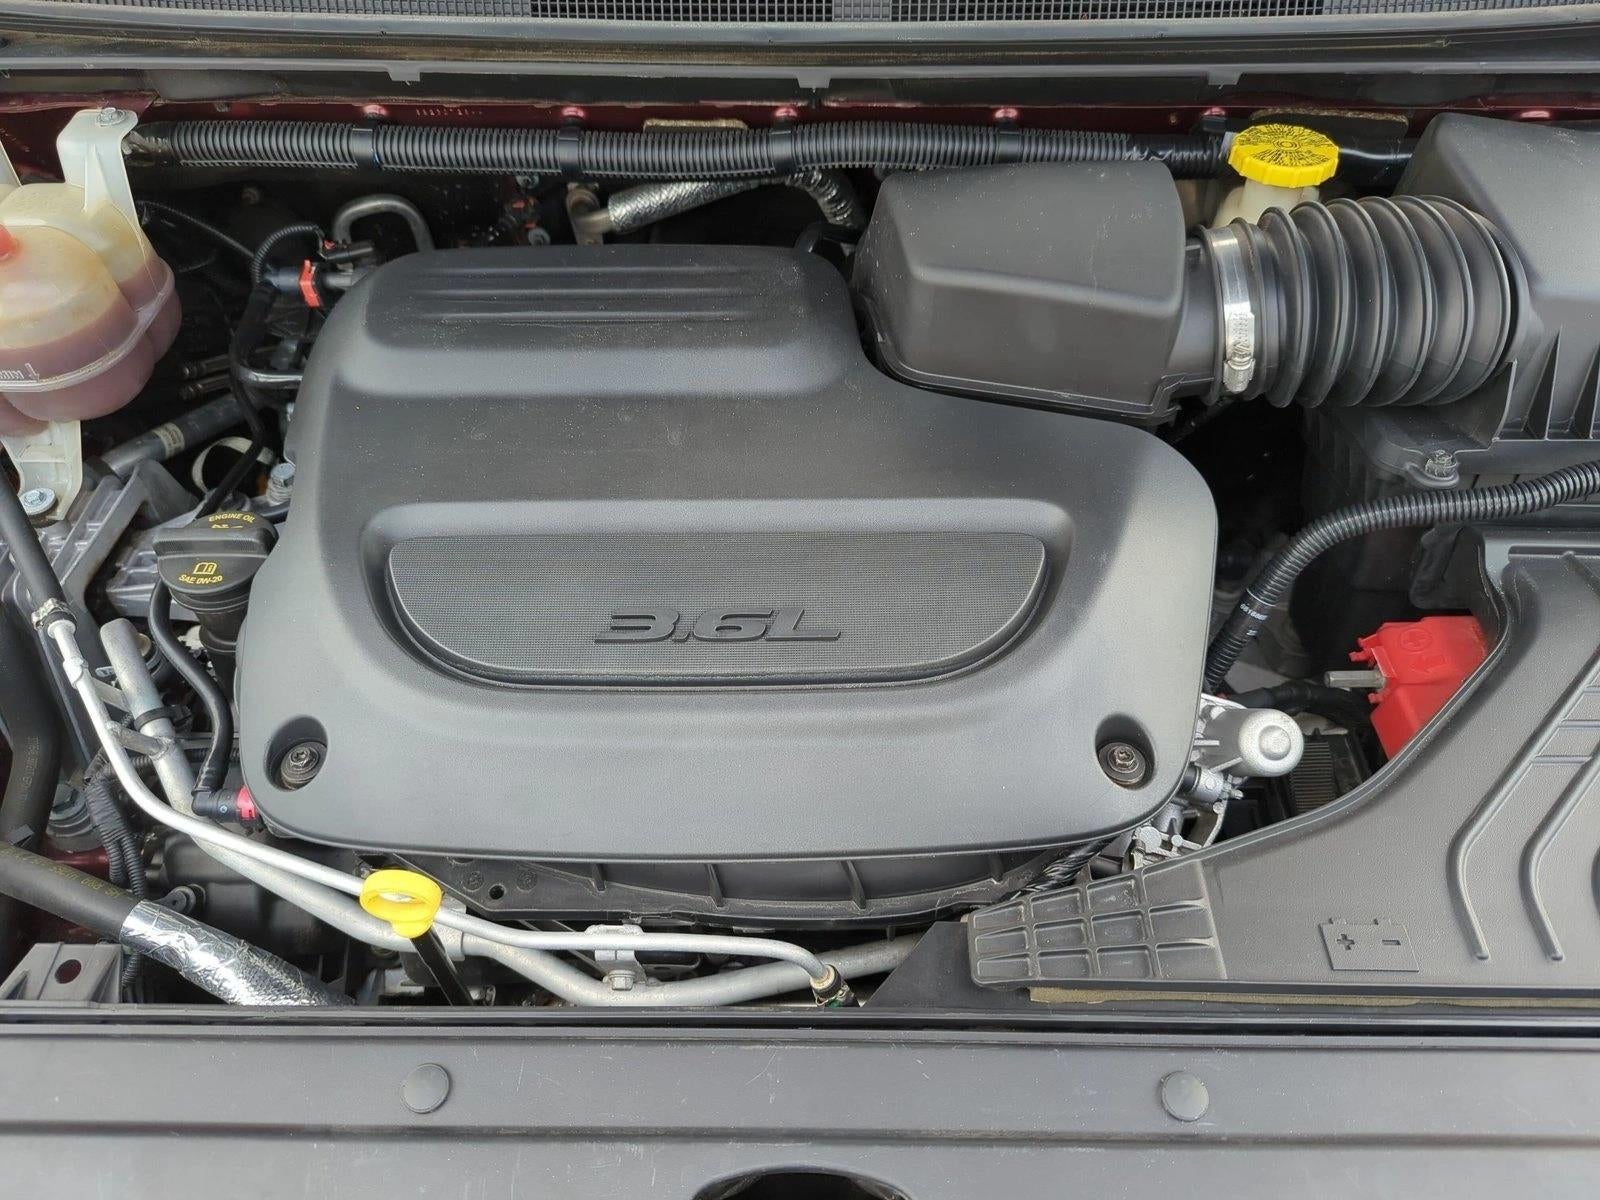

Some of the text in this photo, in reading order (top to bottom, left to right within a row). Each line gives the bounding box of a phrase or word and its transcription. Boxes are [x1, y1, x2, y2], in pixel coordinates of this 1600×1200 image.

[208, 513, 256, 523] ENGINE OIL
[179, 574, 223, 584] SAE 0W-20
[595, 608, 842, 643] 3.6L
